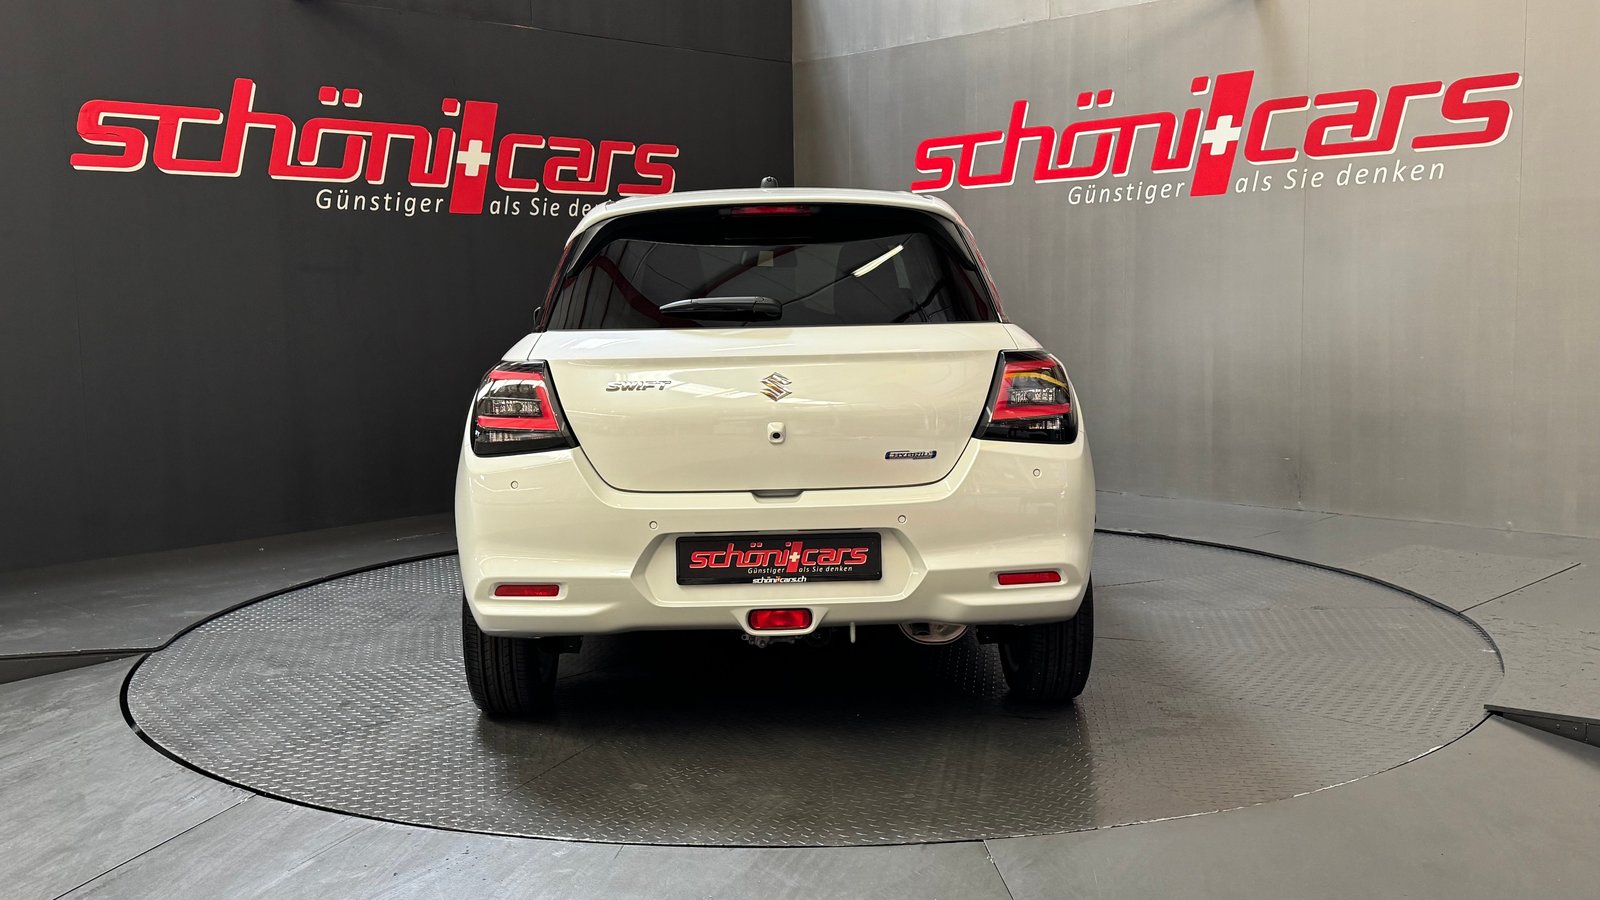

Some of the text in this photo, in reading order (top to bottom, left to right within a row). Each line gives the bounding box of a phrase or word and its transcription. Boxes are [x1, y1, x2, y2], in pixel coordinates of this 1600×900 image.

[1068, 159, 1445, 205] Günstiger als Sie denken
[315, 188, 444, 217] Günstiger
[489, 195, 521, 216] als
[530, 197, 561, 217] Sie
[606, 380, 671, 392] SWIFT
